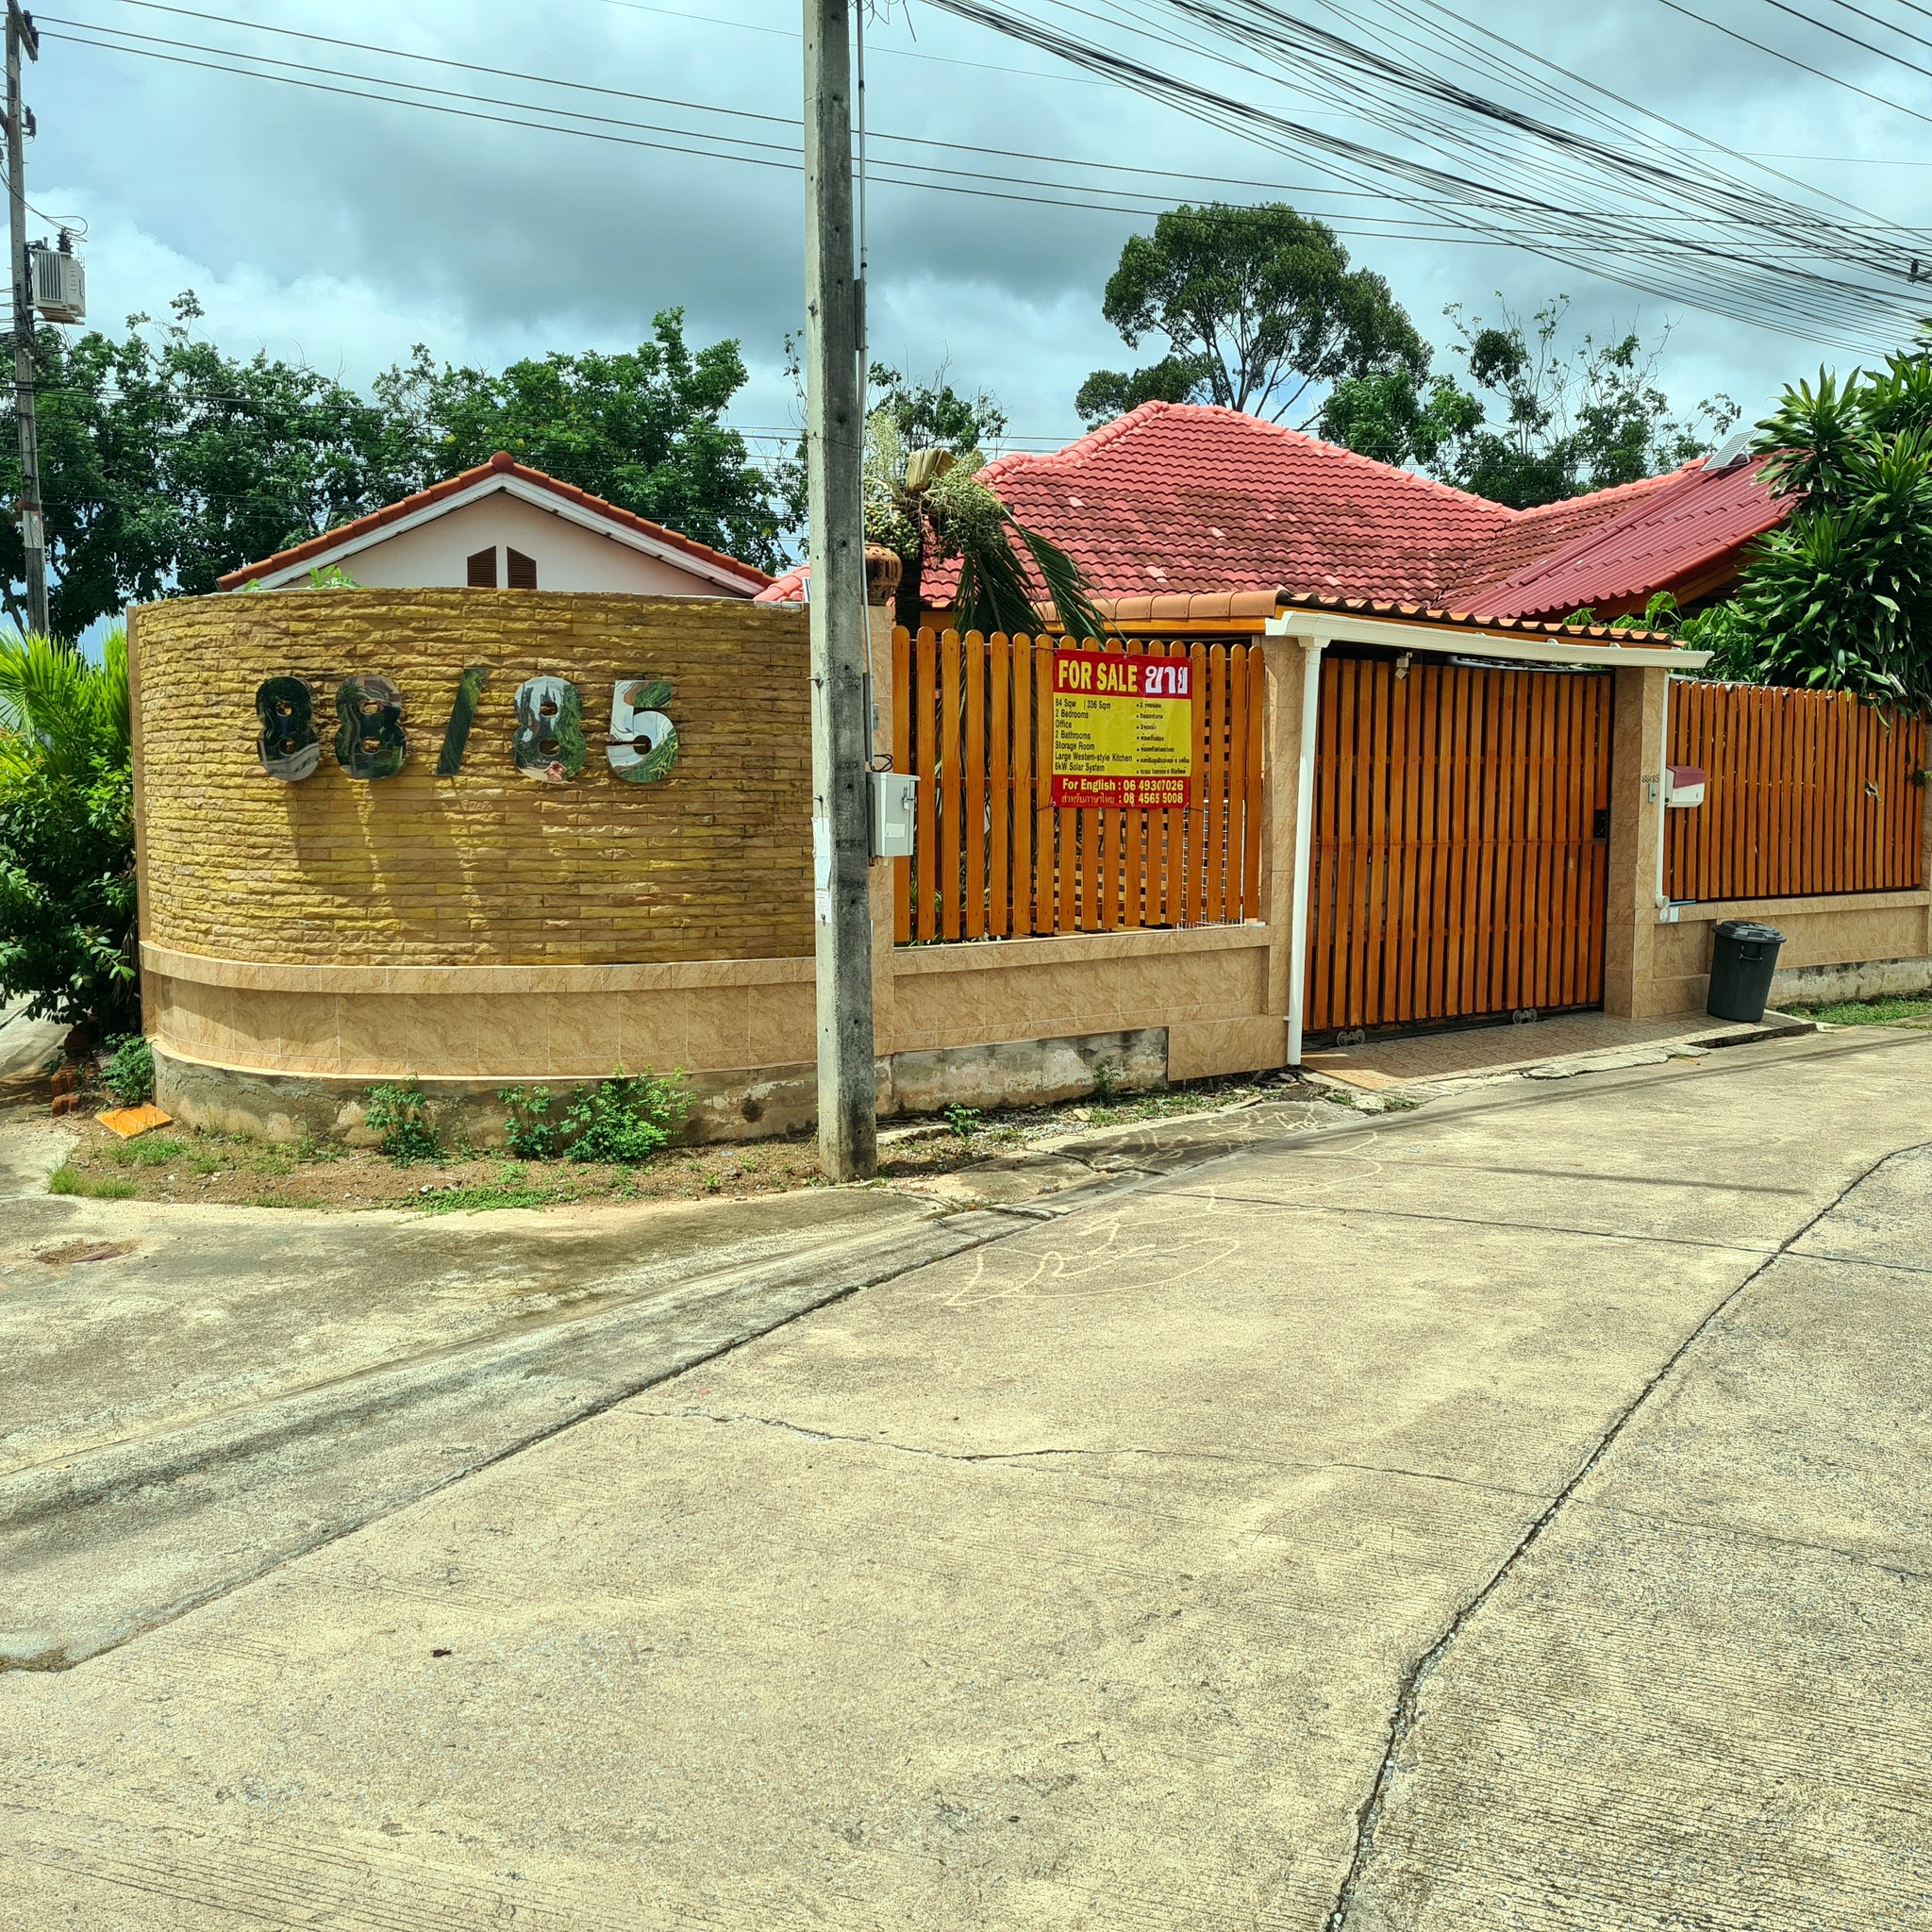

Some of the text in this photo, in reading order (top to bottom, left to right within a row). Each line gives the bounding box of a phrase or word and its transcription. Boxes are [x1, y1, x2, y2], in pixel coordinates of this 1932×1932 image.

[1058, 660, 1138, 692] FOR SALE
[1144, 665, 1189, 694] ขาย
[1056, 698, 1110, 710] 84 Sqw 336 Sqm
[1061, 709, 1089, 719] Bedrooms
[256, 668, 680, 782] 88/85
[1056, 720, 1072, 728] Office
[1061, 730, 1091, 740] Bathrooms
[1056, 741, 1094, 751] Storage Room
[1056, 751, 1071, 761] Large
[1112, 754, 1132, 762] Kitchen
[1055, 762, 1105, 773] 6kW Solar System
[1062, 778, 1078, 790] For
[1081, 779, 1115, 792] English
[1124, 780, 1136, 791] 06
[1124, 793, 1135, 804] 08
[1139, 793, 1159, 803] 4565
[1162, 792, 1183, 803] 5008
